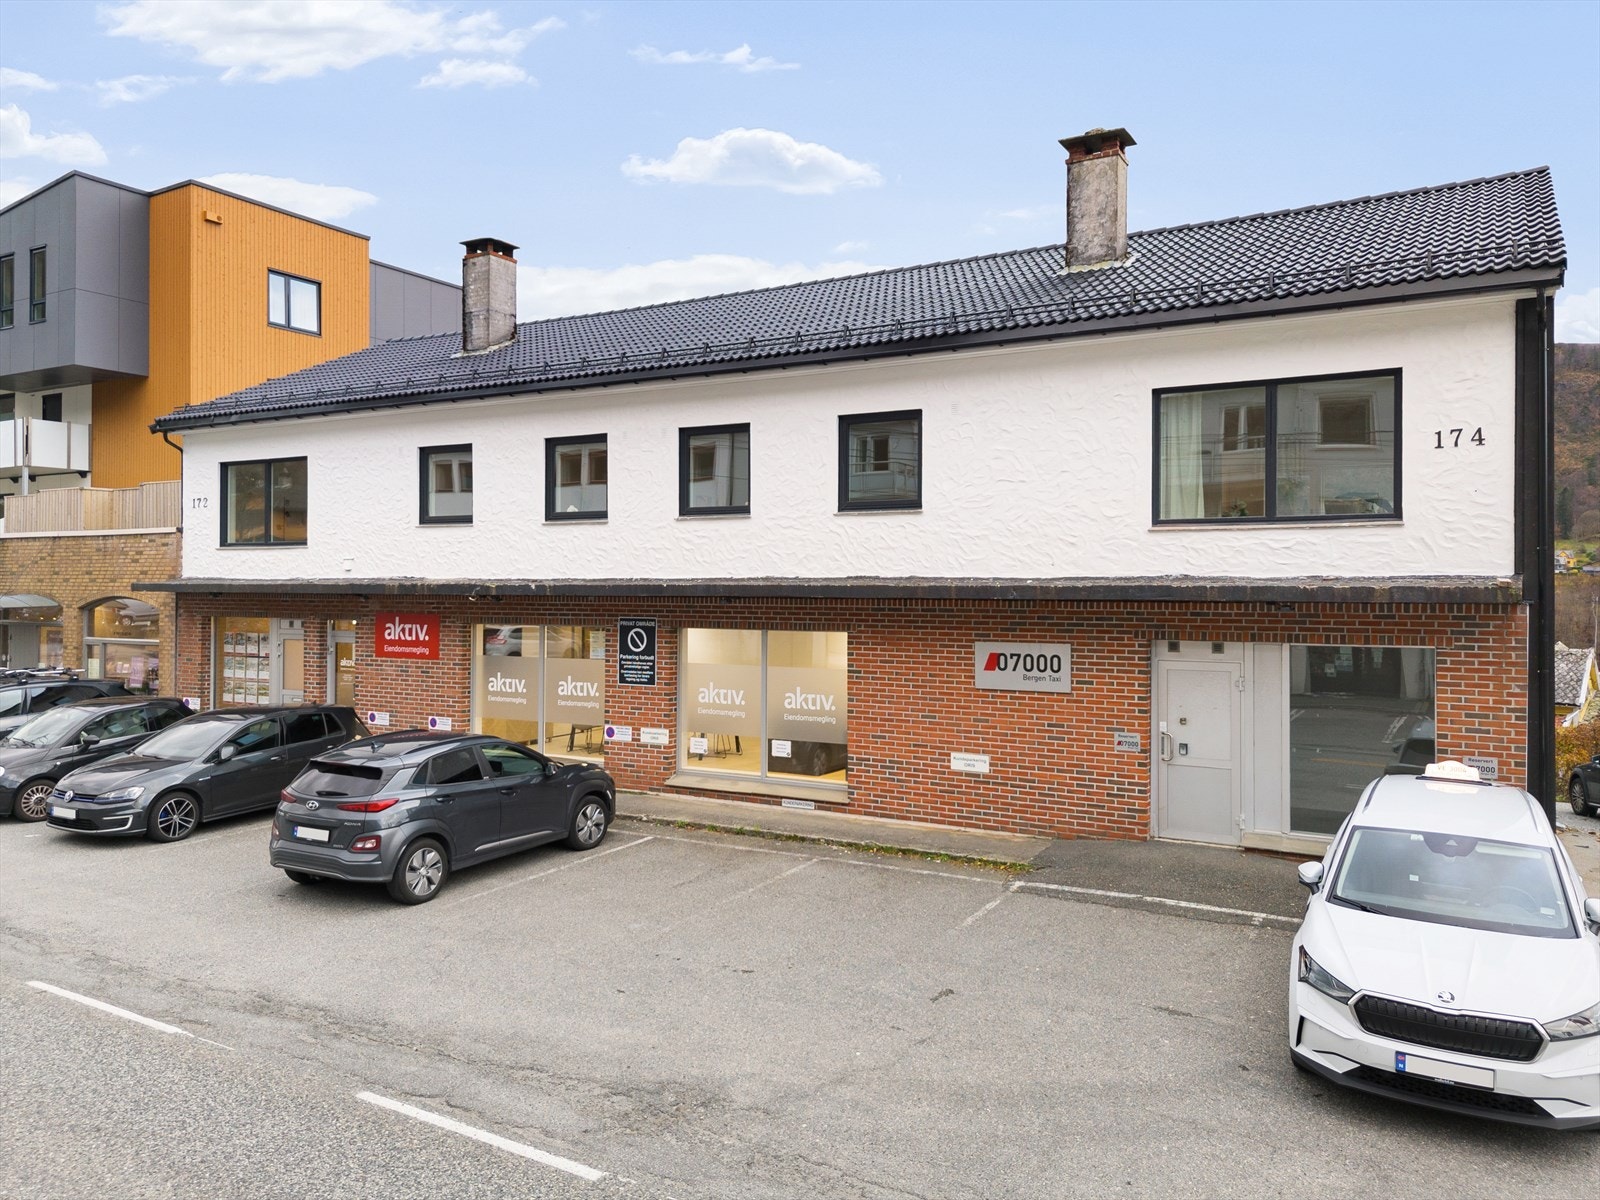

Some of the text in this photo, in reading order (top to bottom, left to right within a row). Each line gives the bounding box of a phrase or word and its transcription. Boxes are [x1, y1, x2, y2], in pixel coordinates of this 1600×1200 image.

[1434, 427, 1486, 449] 174
[192, 497, 209, 509] 172
[384, 616, 429, 641] aktiv.
[384, 644, 430, 656] Eiendomsmegling
[997, 652, 1062, 673] 07000
[488, 672, 527, 693] aktiv.
[1022, 674, 1062, 683] Bergen Taxi
[557, 675, 600, 697] aktiv.
[487, 695, 527, 705] Eiendomsmegling
[698, 682, 746, 706] aktiv.
[784, 686, 836, 711] aktiv.
[557, 699, 600, 709] Eiendomsmegling
[697, 706, 746, 719] Eiendomsmegling
[783, 713, 837, 725] Eiendomsmegling
[1475, 765, 1496, 774] 7000
